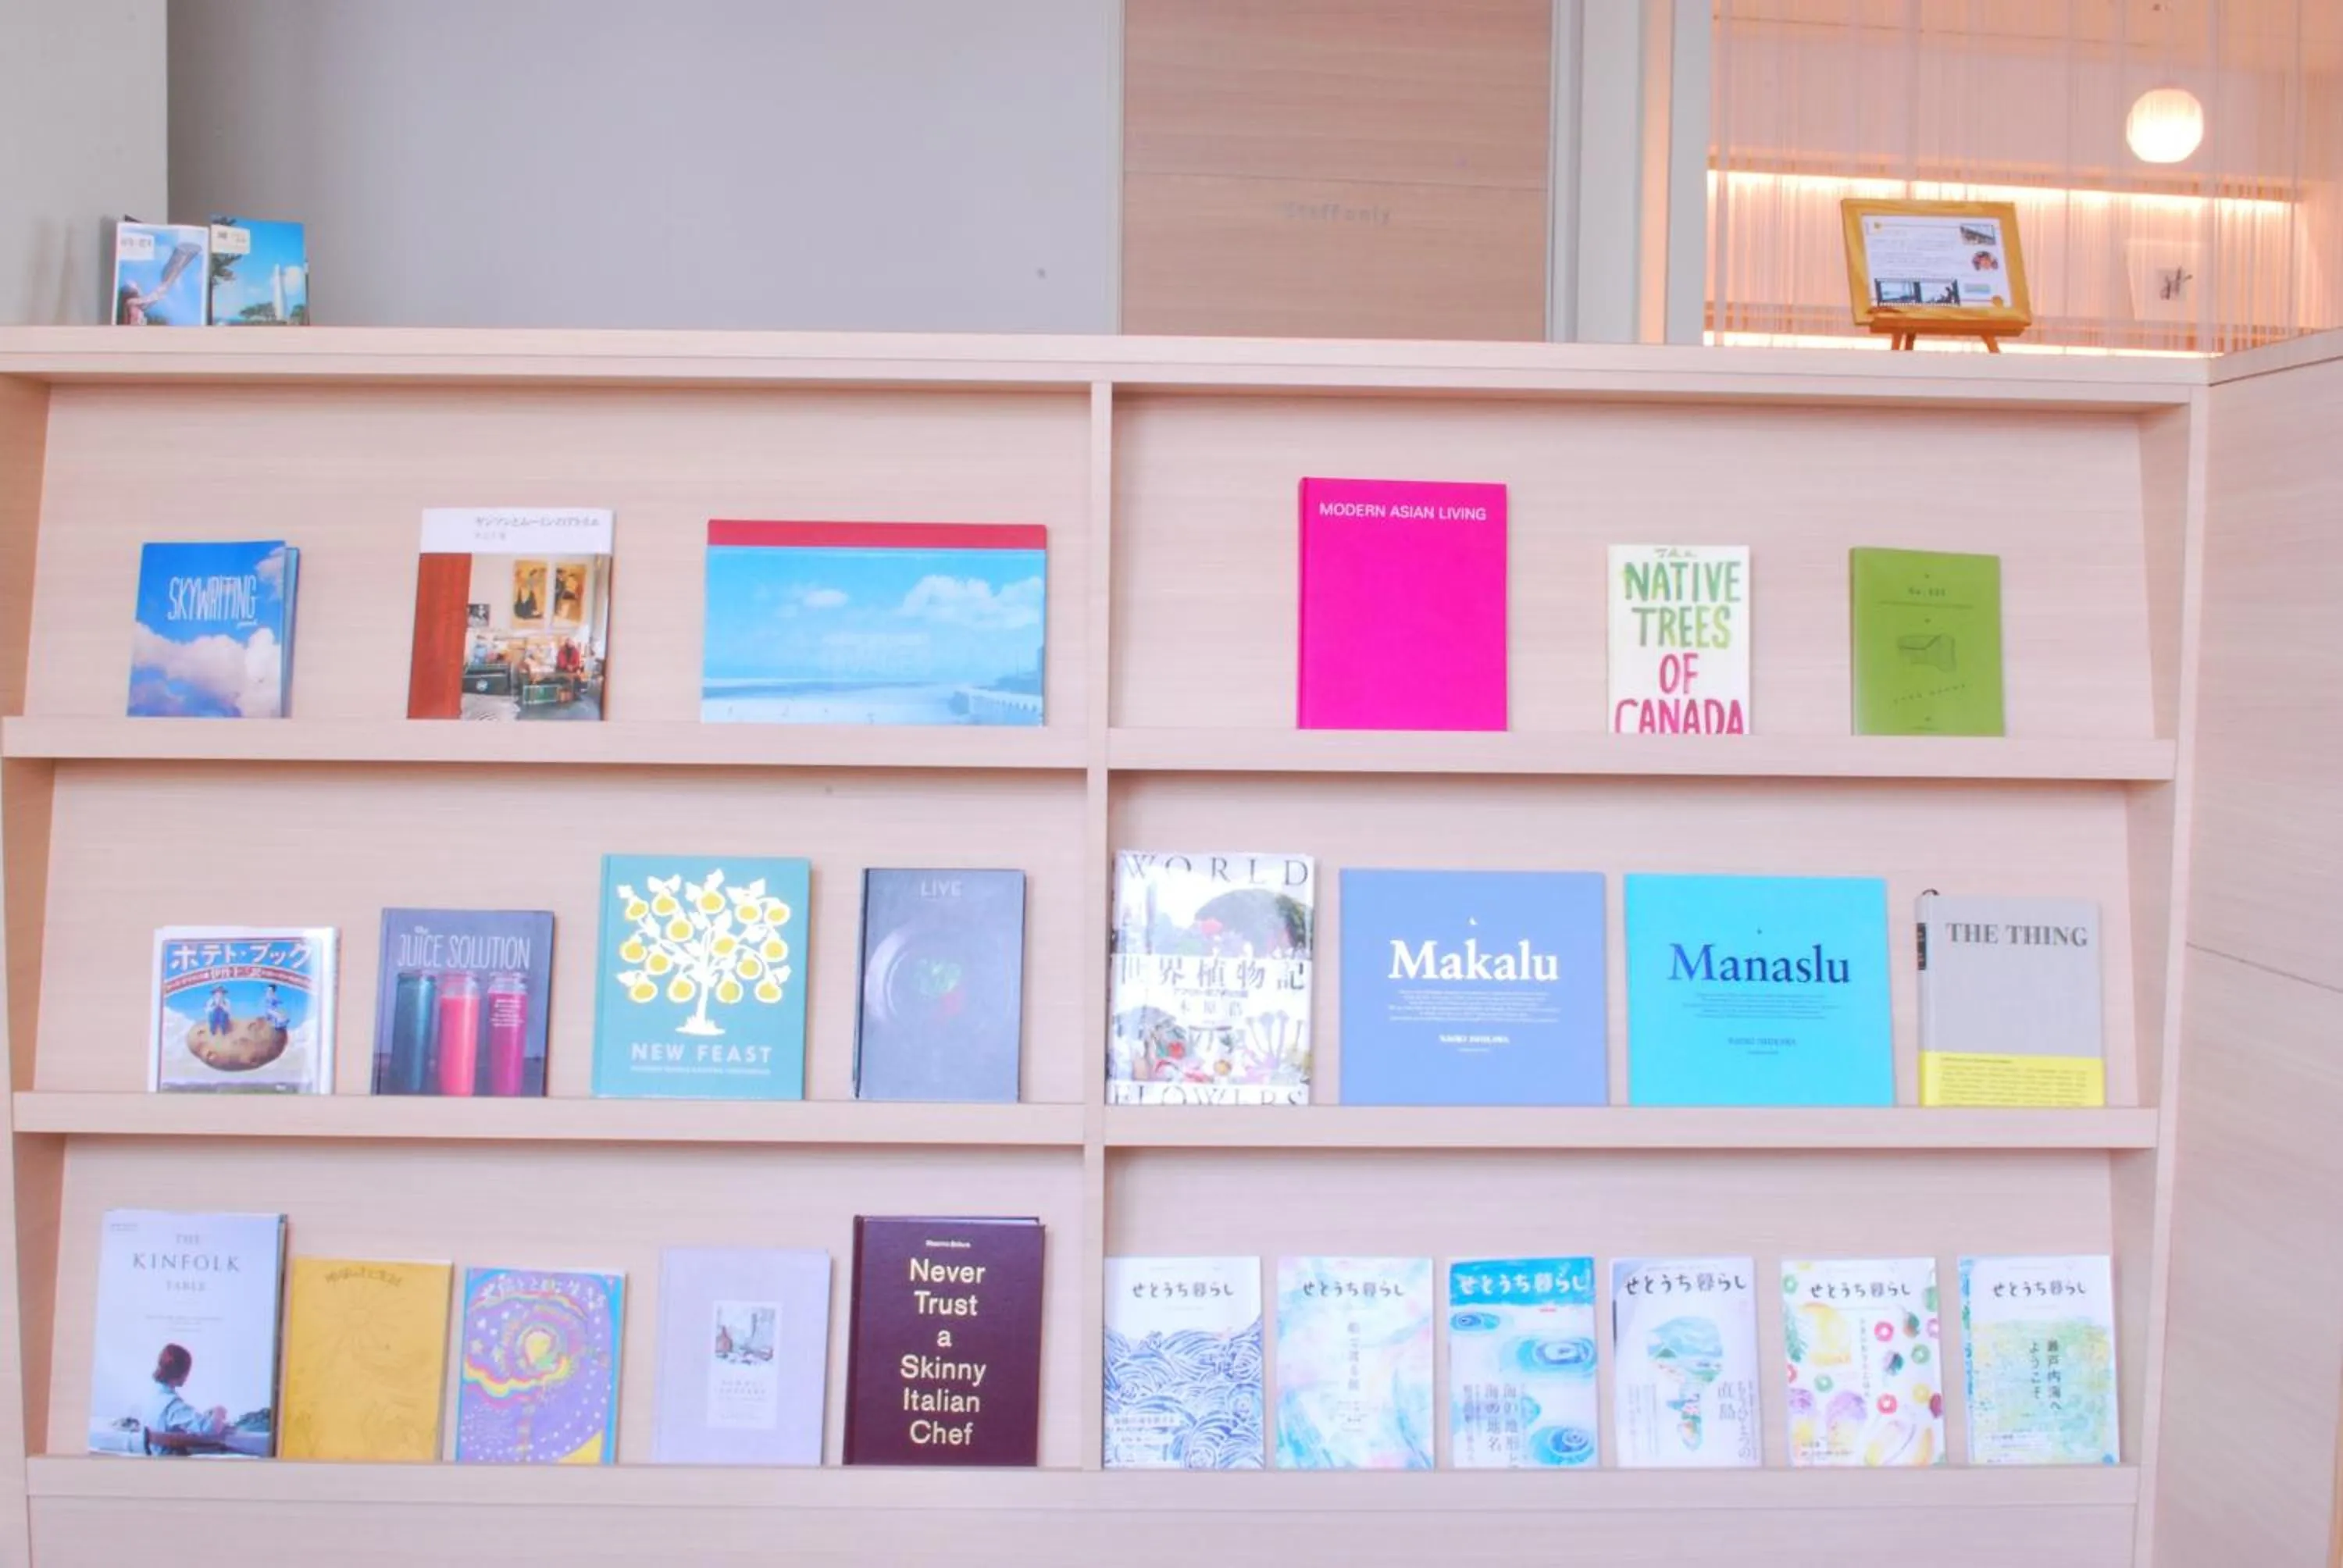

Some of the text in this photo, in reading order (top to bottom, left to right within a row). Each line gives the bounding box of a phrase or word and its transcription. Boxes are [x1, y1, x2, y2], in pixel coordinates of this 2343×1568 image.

[1319, 502, 1486, 521] MODERN ASIAN LIVING
[1623, 561, 1741, 602] NATIVE
[167, 574, 258, 622] SKYWRITING
[1632, 605, 1731, 649] TREES
[1659, 652, 1699, 694] OF
[1614, 699, 1744, 735] CANADA
[1123, 853, 1309, 886] WORLD
[921, 879, 962, 897] LIVE
[1946, 922, 2088, 947] THE THING
[397, 934, 531, 970] JUICE SOLUTION
[1388, 938, 1561, 982] Makalu
[1668, 943, 1851, 983] Manaslu
[631, 1042, 772, 1063] NEW FEAST
[132, 1252, 241, 1272] KINFOLK
[908, 1257, 986, 1283] Never
[166, 1279, 207, 1291] TABLE
[1132, 1281, 1234, 1298] せとうち暮らし
[1303, 1281, 1406, 1297] せとうち暮らし
[1625, 1273, 1747, 1295] せとうち暮らし
[1810, 1281, 1911, 1298] せとうち暮らし
[1993, 1280, 2088, 1297] せとうち暮らし
[914, 1290, 978, 1316] Trust
[936, 1330, 952, 1347] a
[900, 1354, 986, 1387] Skinny
[903, 1387, 980, 1413] Italian
[910, 1420, 973, 1445] Chef
